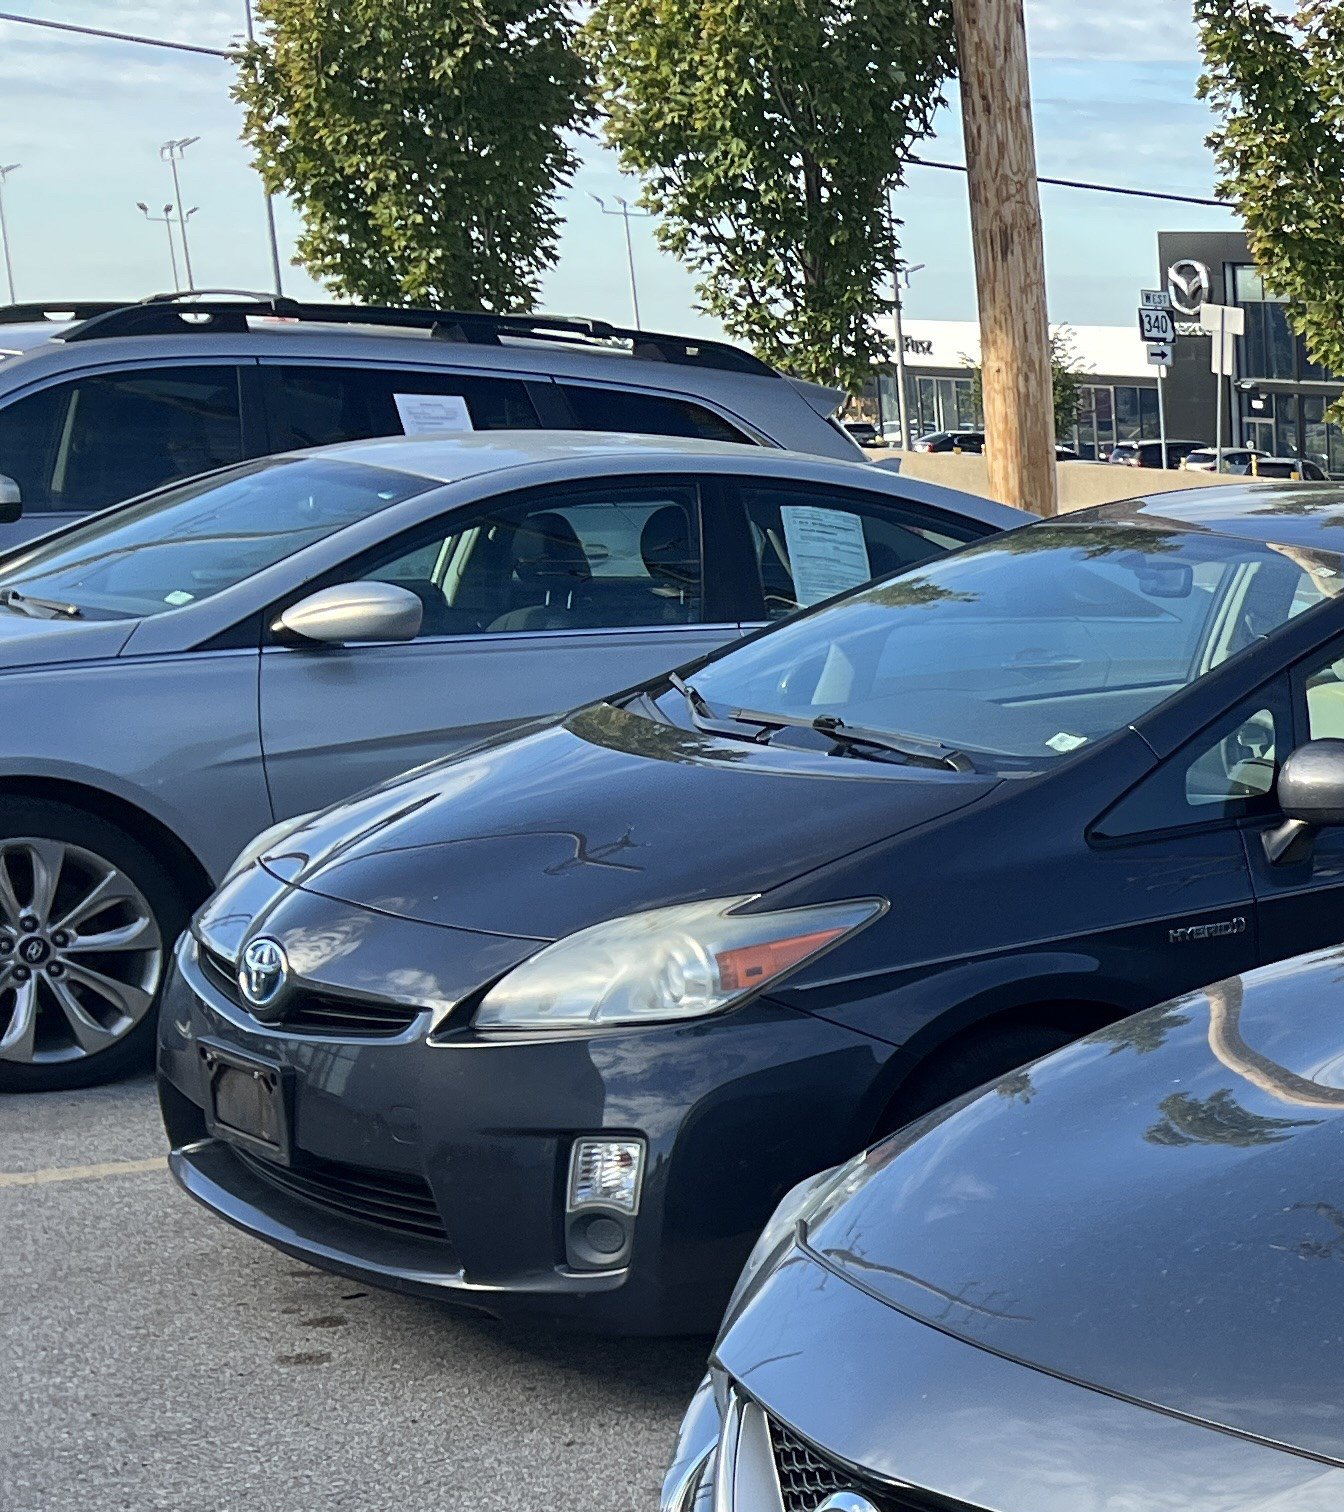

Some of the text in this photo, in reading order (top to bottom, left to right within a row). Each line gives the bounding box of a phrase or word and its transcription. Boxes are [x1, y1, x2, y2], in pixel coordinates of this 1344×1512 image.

[1144, 293, 1167, 304] WEST
[1145, 314, 1168, 333] 340
[1168, 921, 1233, 943] HYBRID
